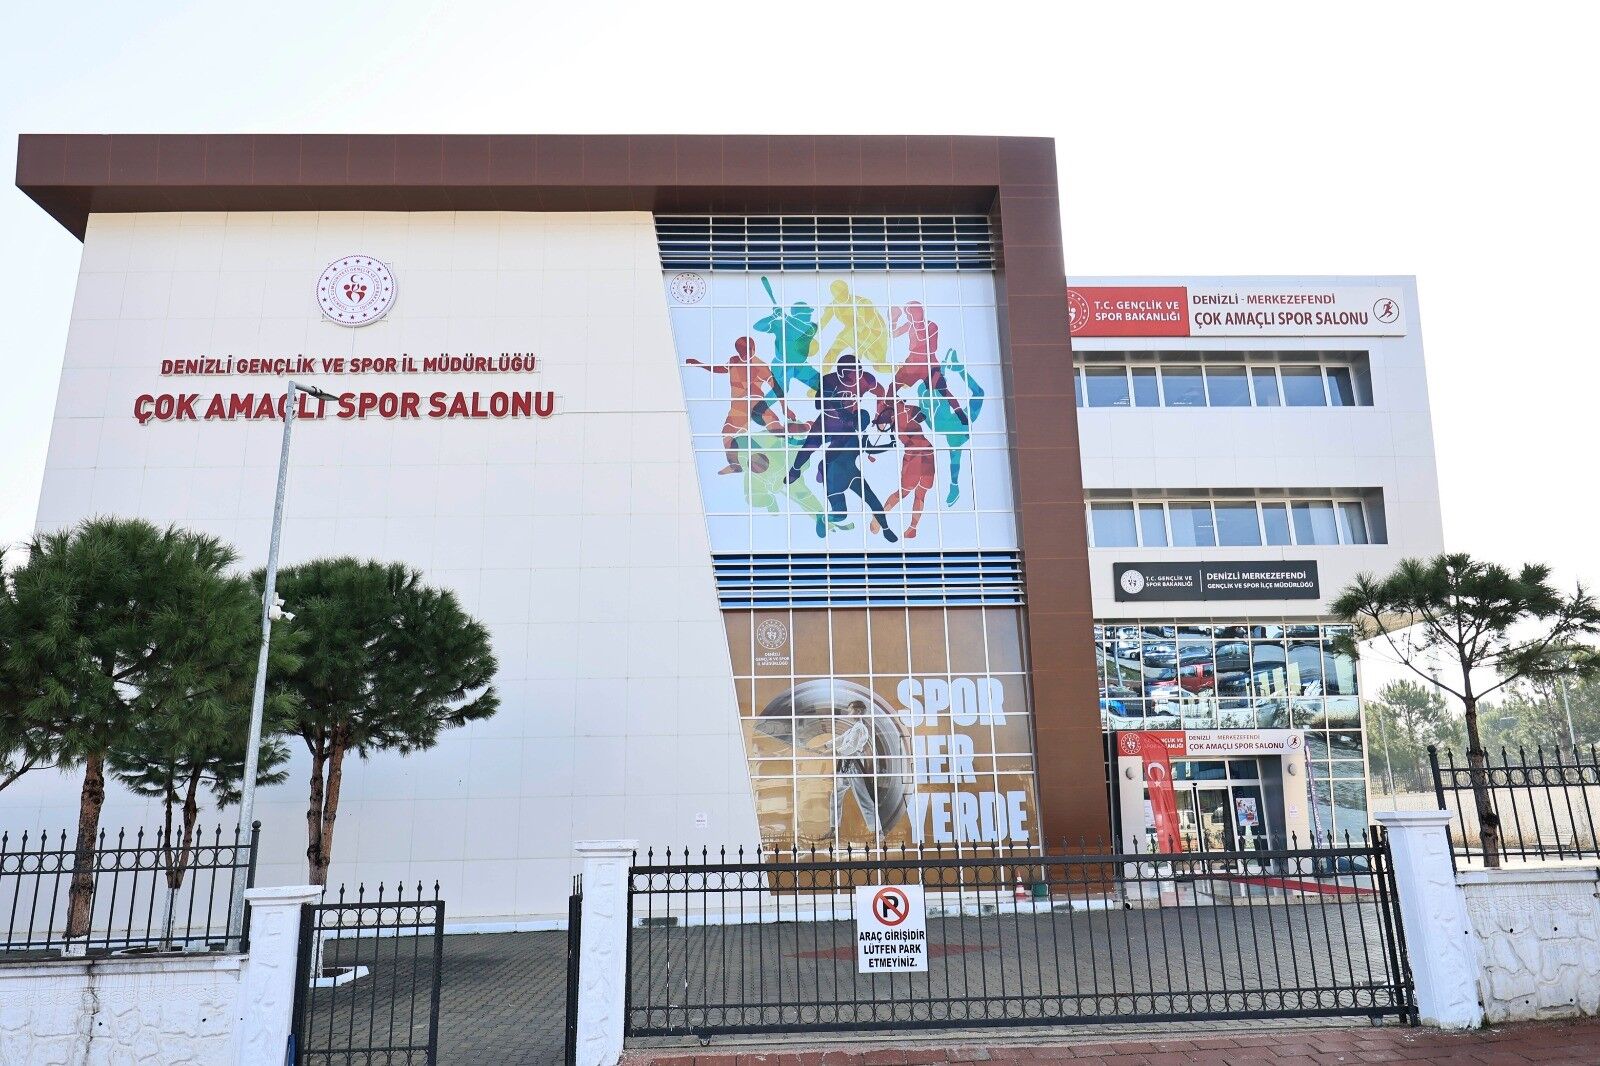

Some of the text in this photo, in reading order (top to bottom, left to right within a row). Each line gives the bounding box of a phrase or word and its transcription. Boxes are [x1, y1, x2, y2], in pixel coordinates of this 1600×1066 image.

[1094, 300, 1179, 311] T.C. GENÇLİK VE
[1192, 293, 1239, 305] DENİZLİ
[1247, 293, 1336, 304] MERKEZEFENDİ
[1095, 311, 1180, 321] SPOR BAKANLIĞI
[1194, 312, 1368, 329] ÇOK AMAÇLI SPOR SALONU
[161, 353, 536, 375] DENİZLİ GENÇLİK VE SPOR İL MÜDÜRLÜĞÜ
[134, 393, 199, 424] ÇOK
[336, 392, 420, 418] SPOR
[428, 391, 554, 418] SALONU
[1206, 571, 1306, 580] DENİZLİ MERKEZEFENDİ
[896, 677, 1006, 728] SPOR
[1206, 743, 1233, 751] AMAÇLI
[903, 791, 1030, 843] YERDE
[859, 928, 925, 943] ARAÇ GİRİŞİDİR
[864, 943, 921, 954] LÜTFEN PARK
[868, 955, 918, 968] ETMEYİNİZ.
